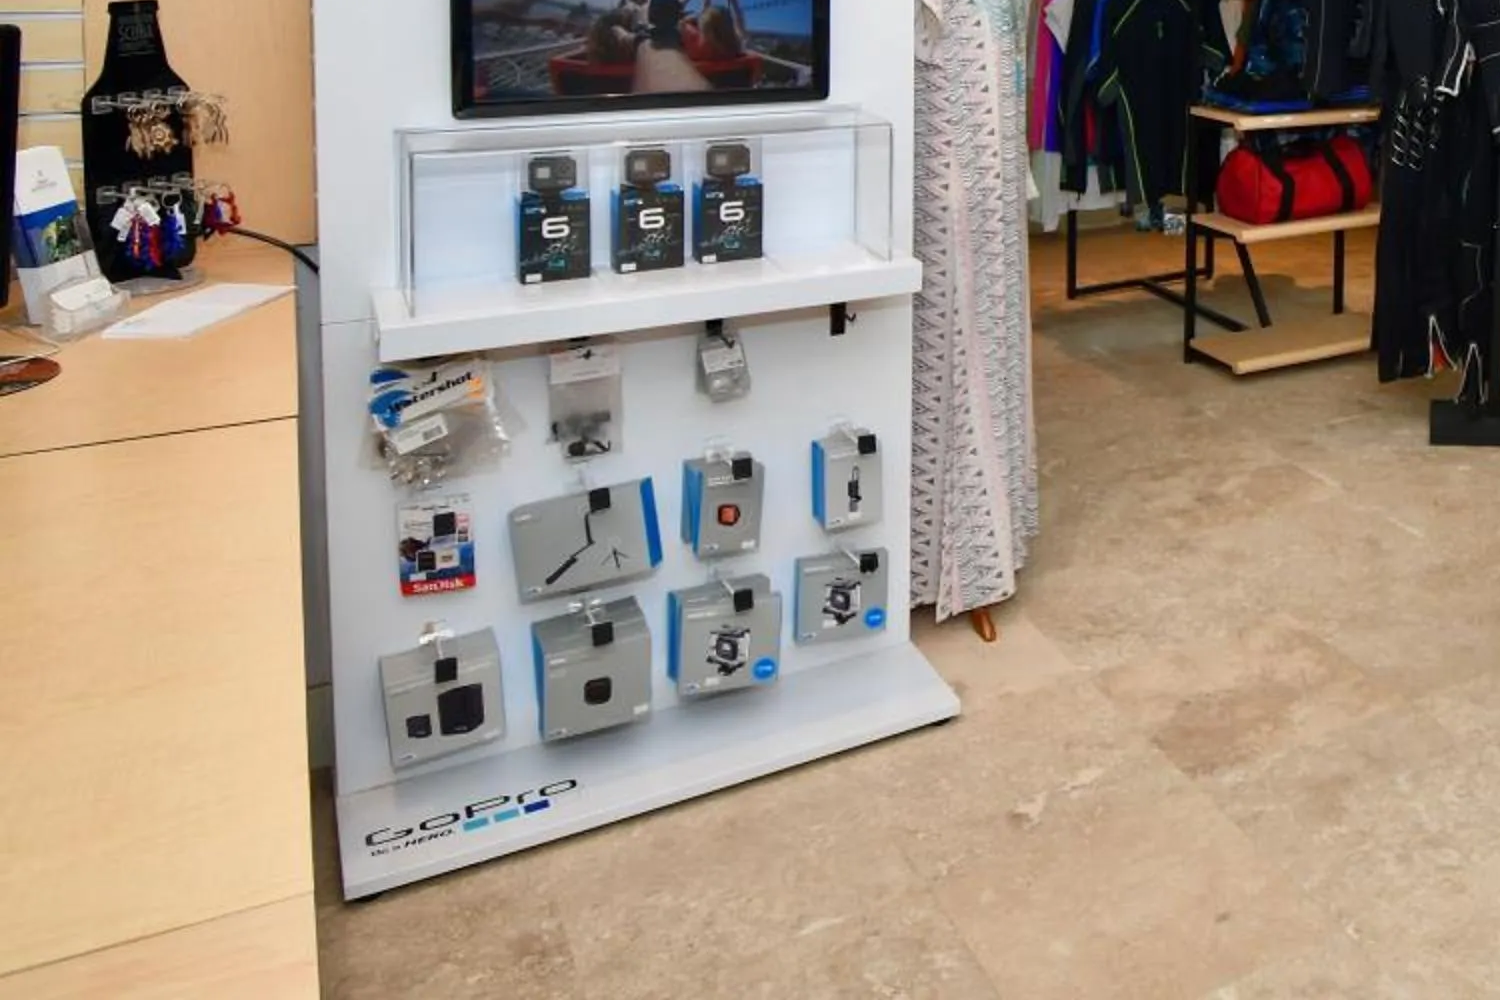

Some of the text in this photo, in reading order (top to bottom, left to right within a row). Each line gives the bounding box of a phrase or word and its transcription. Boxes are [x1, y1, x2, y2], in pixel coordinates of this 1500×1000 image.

[639, 208, 665, 229] 6
[719, 201, 745, 222] 6
[541, 216, 571, 238] 6
[388, 371, 473, 414] Watershot
[413, 577, 466, 593] SanDisk
[365, 779, 577, 846] GoPro
